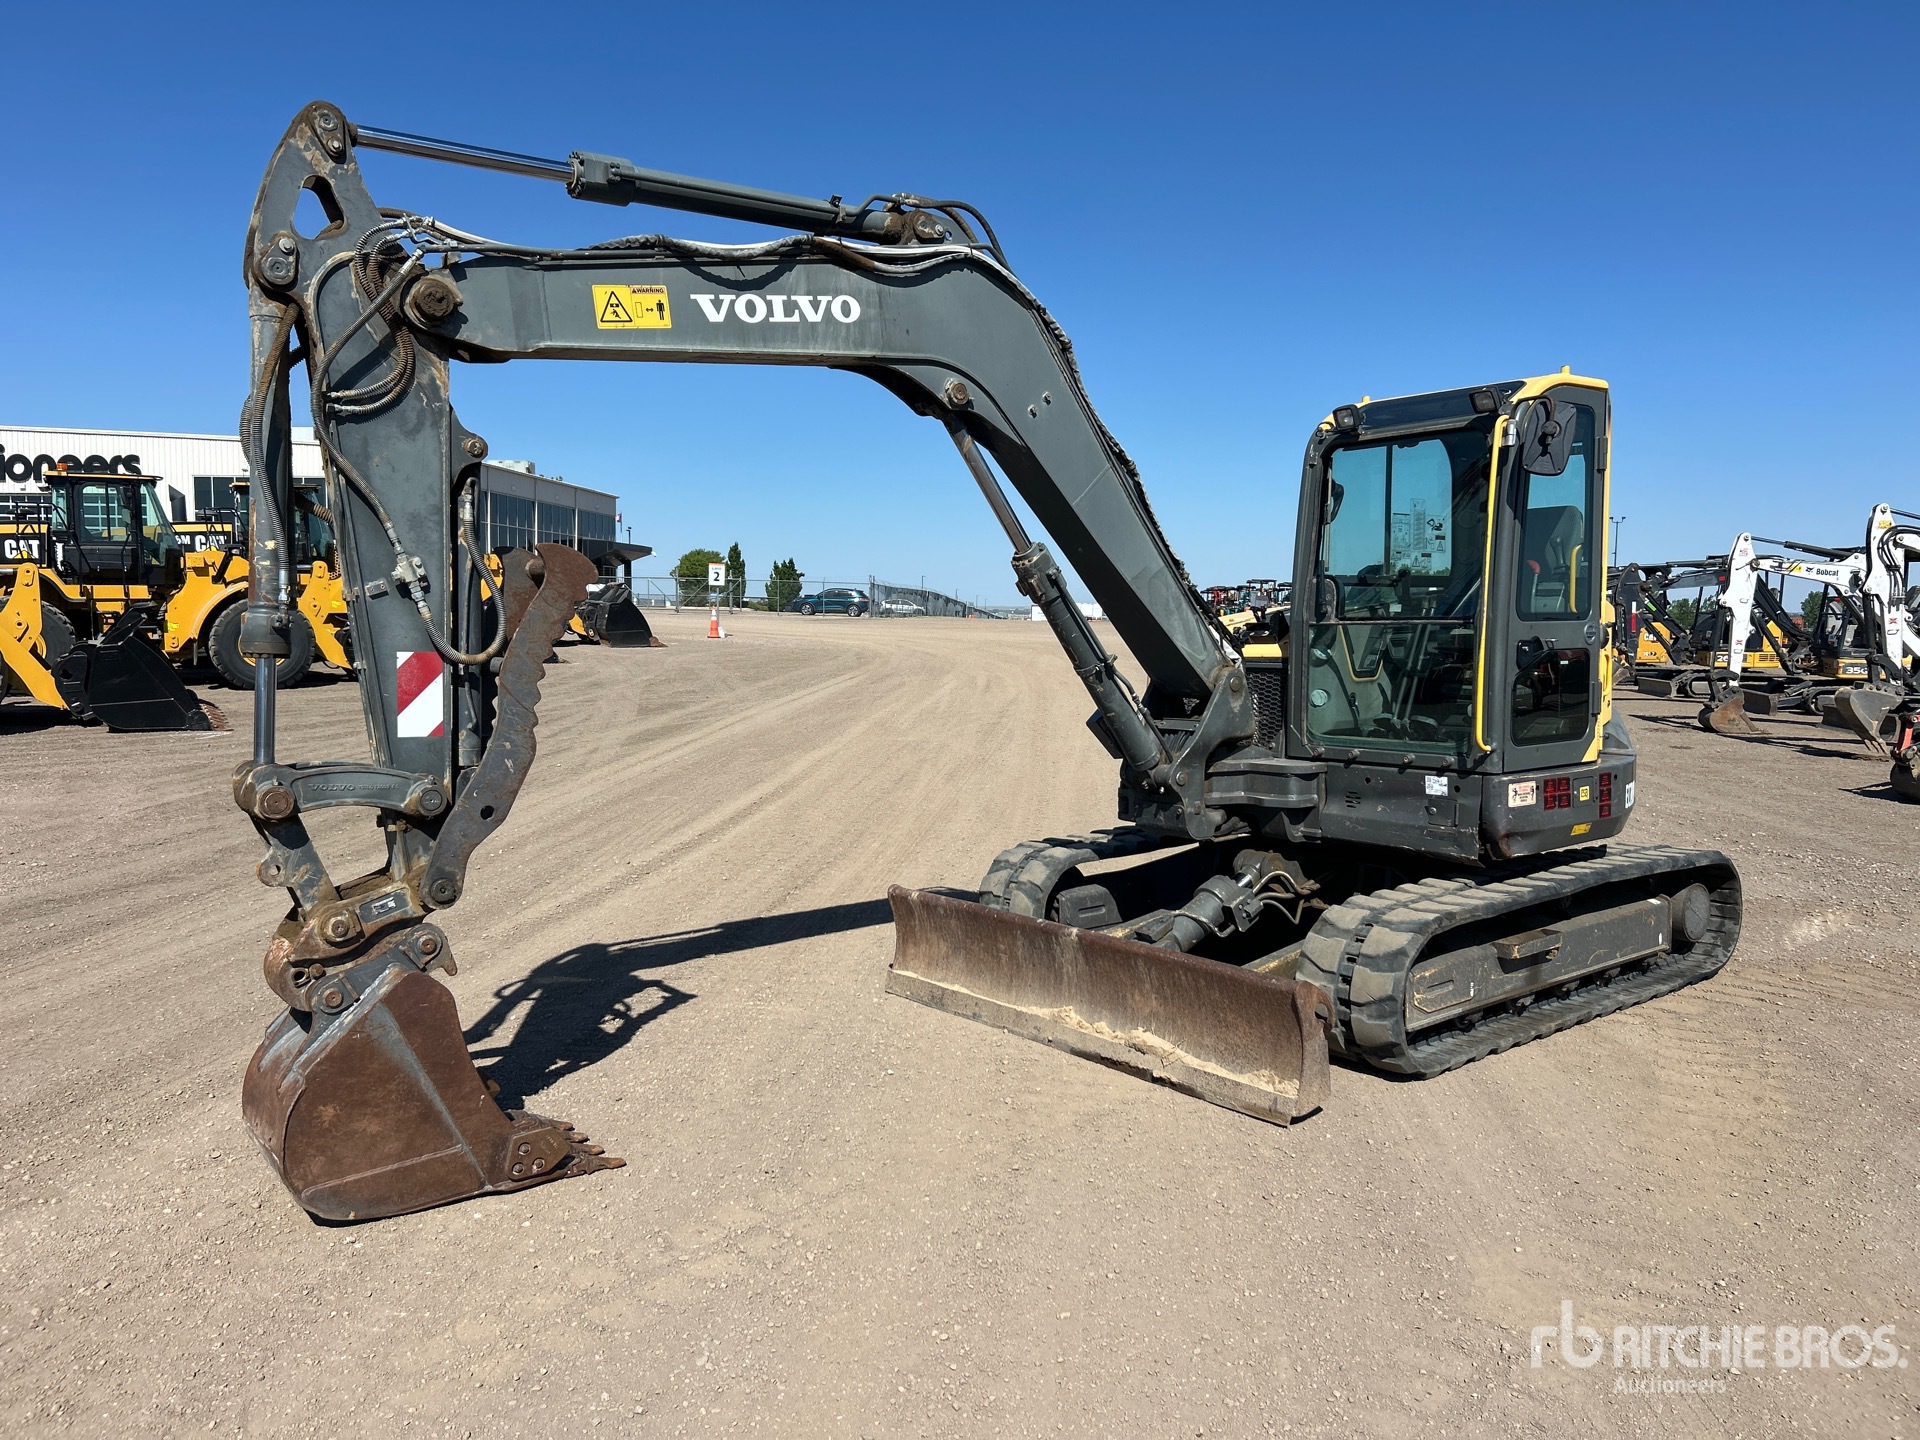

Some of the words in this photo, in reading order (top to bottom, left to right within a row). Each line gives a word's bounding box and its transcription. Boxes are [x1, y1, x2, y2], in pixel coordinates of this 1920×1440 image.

[690, 293, 861, 324] VOLVO
[4, 539, 40, 559] CAT
[713, 571, 720, 582] 2
[1816, 568, 1839, 577] Bobcat
[308, 783, 356, 792] VOLVO
